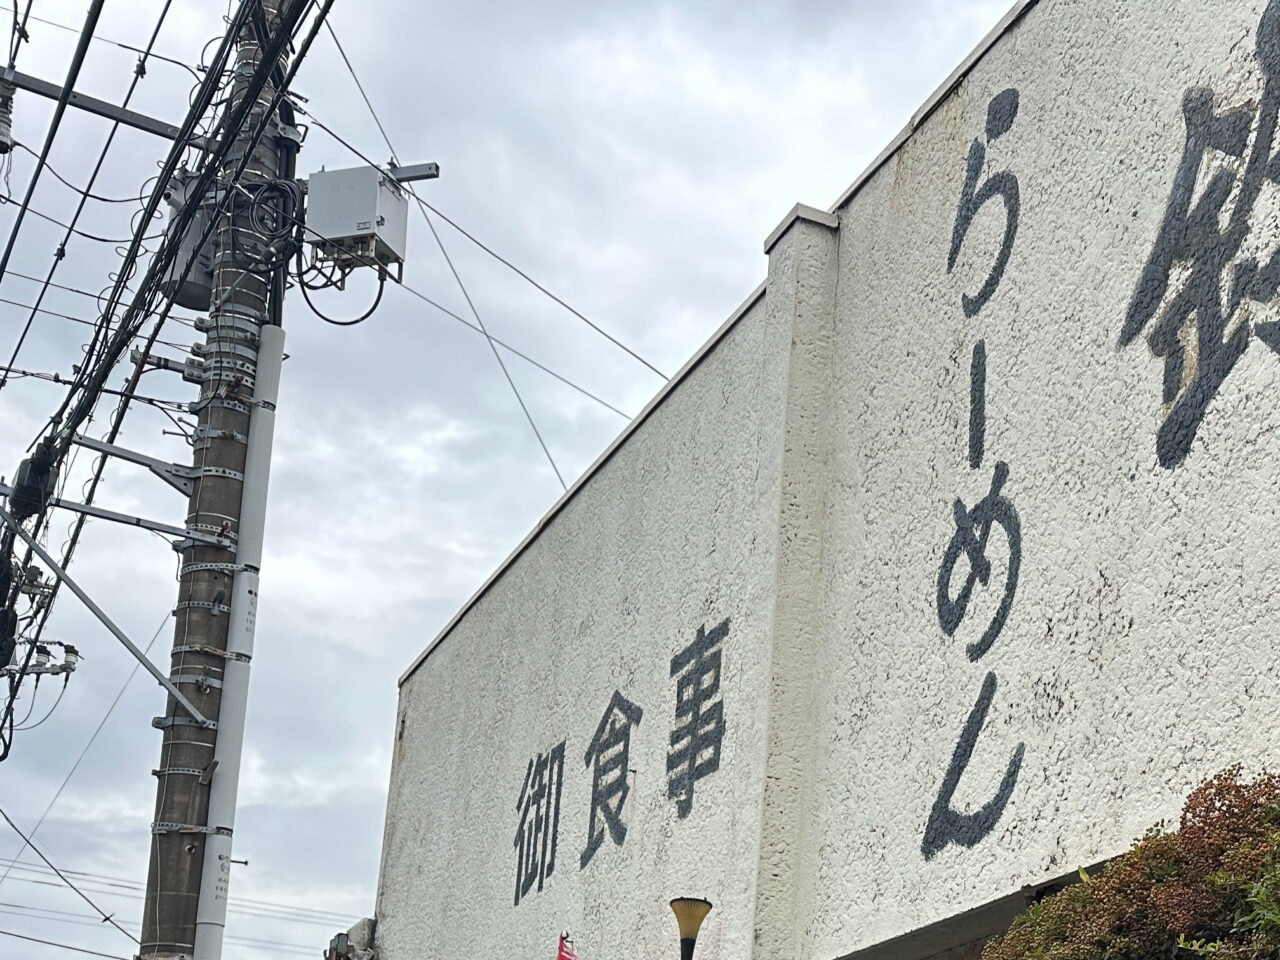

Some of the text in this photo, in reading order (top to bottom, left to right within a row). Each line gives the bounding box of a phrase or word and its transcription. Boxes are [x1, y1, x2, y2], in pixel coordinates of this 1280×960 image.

[921, 88, 1025, 861] らーめん
[514, 616, 732, 906] 御食事
